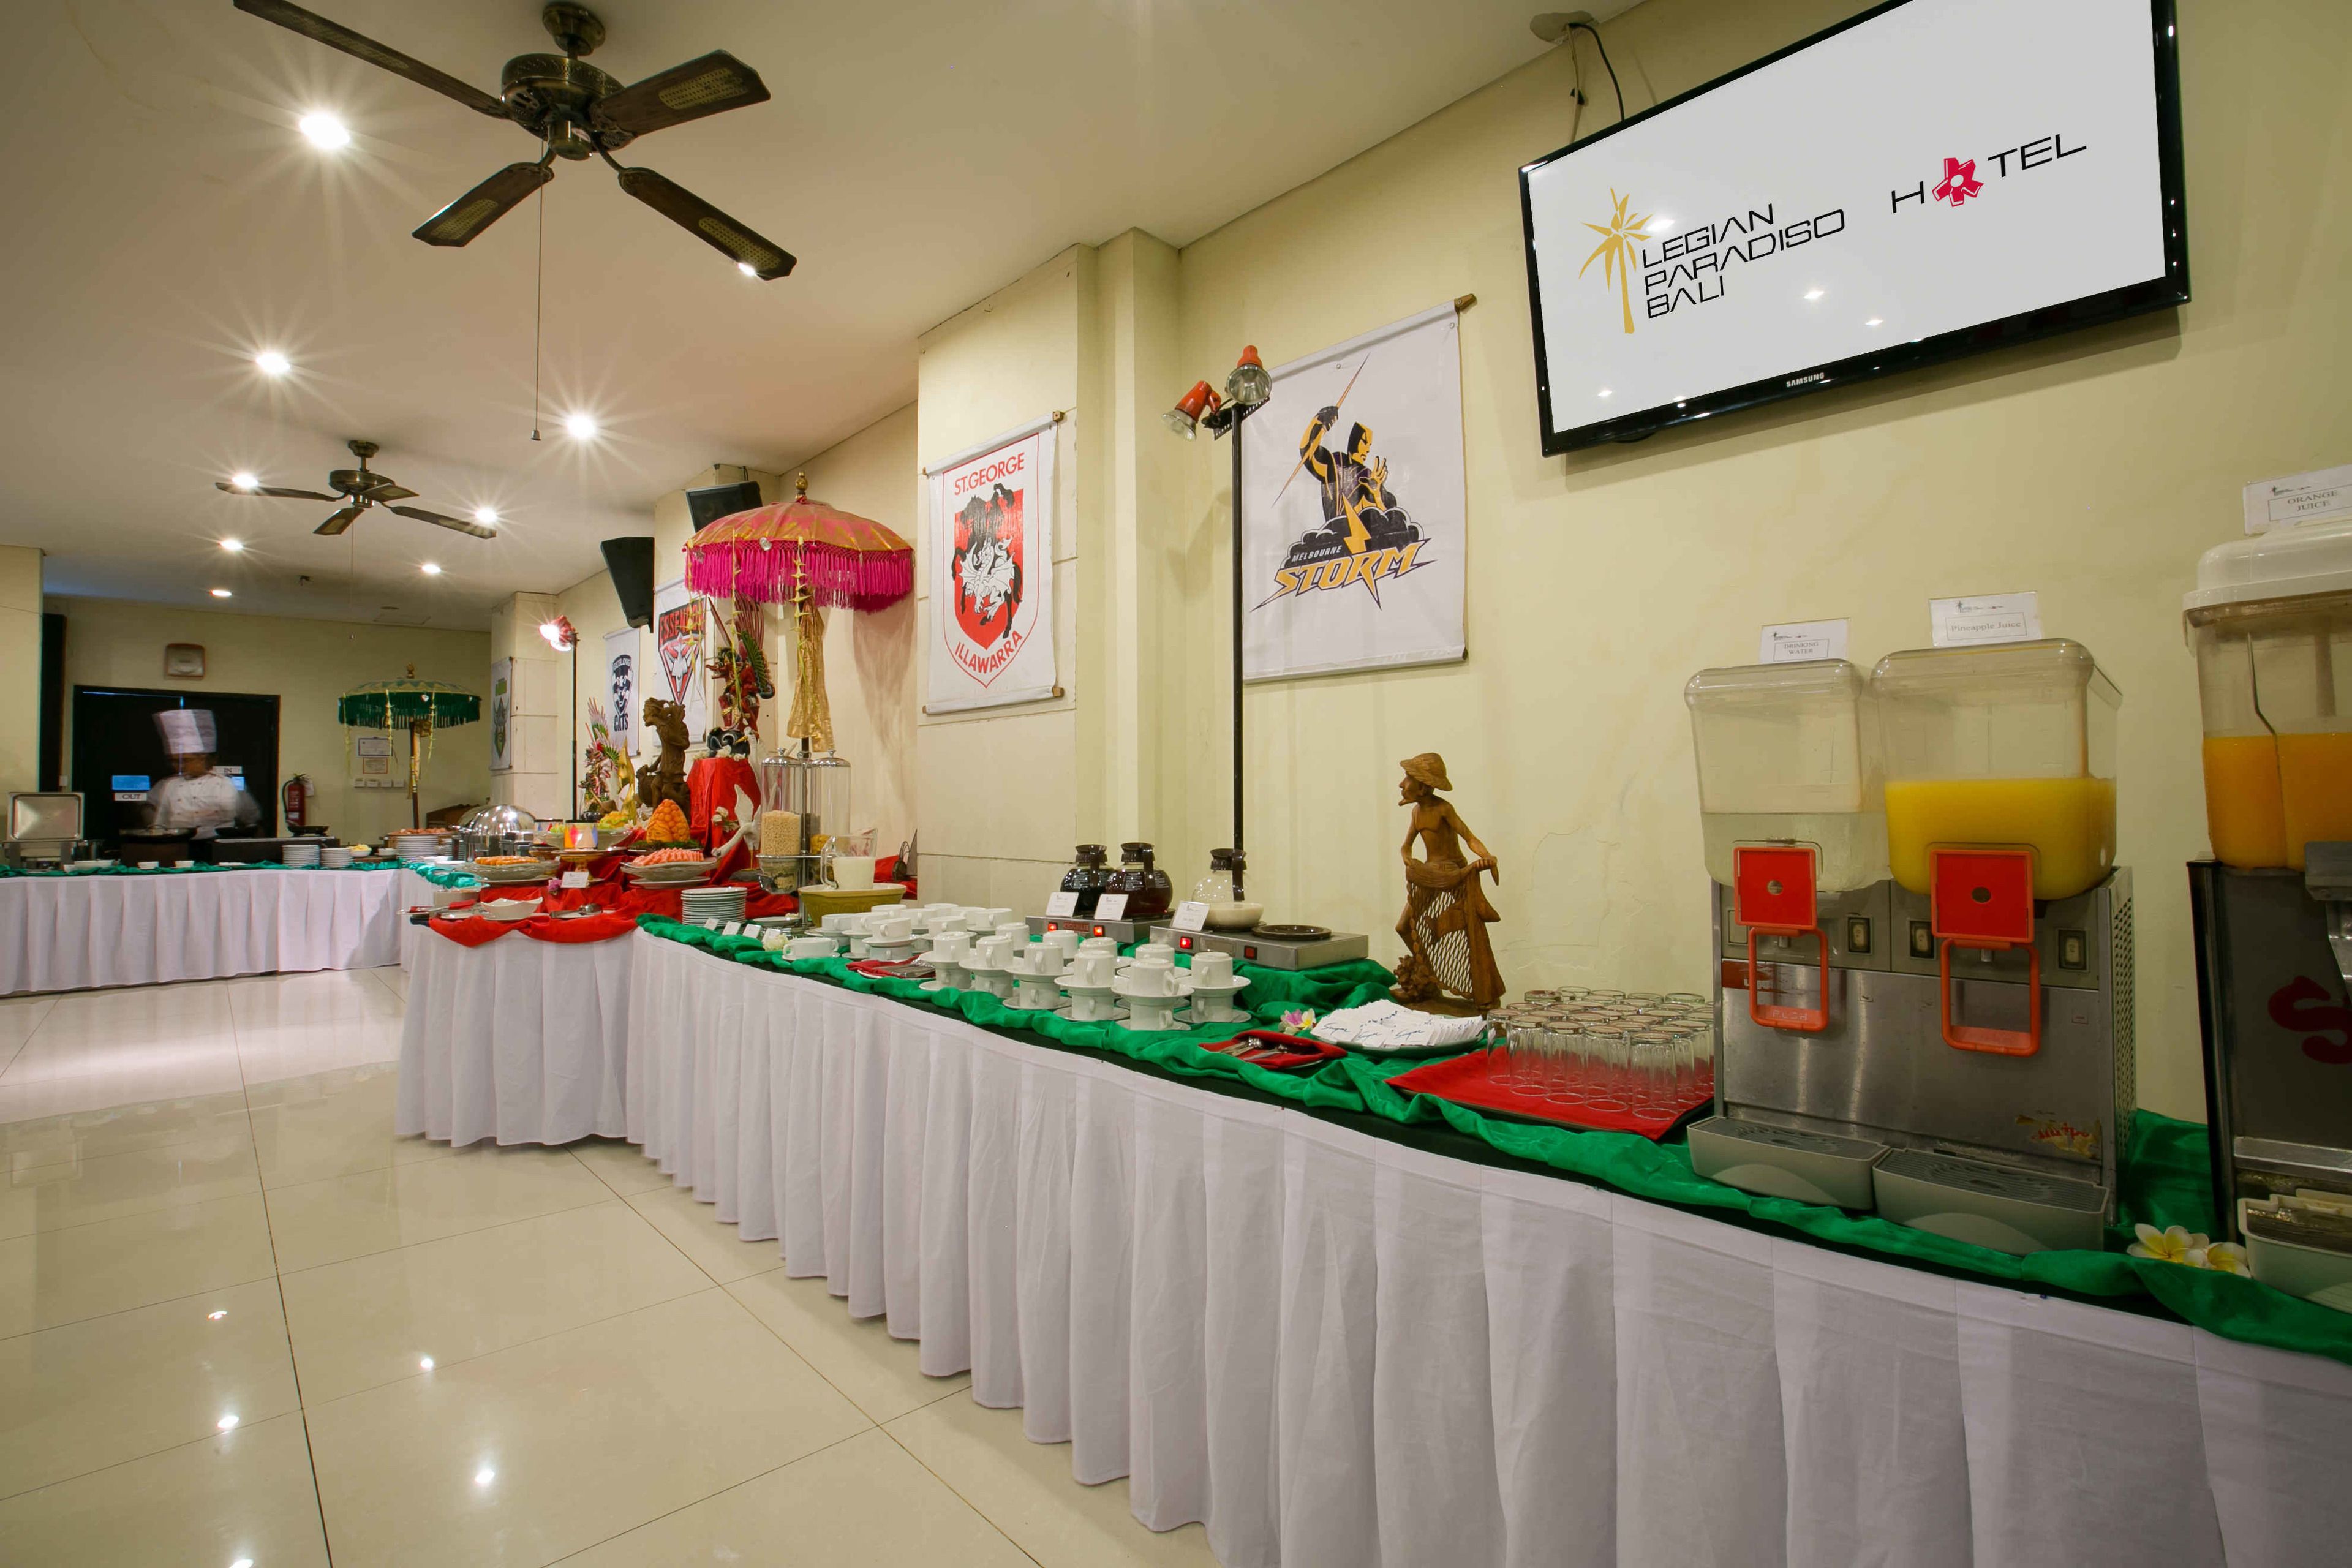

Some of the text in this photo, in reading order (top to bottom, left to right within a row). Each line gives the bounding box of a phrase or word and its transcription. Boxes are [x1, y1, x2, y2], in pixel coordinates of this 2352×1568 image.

[1643, 203, 1774, 268] LEGIAN
[1645, 209, 1845, 295] PARADISO
[1646, 275, 1724, 318] BALI
[1786, 372, 1825, 388] SAMSUNG
[2287, 490, 2339, 505] ORANGE
[2296, 501, 2329, 511] JUICE
[1291, 545, 1343, 562] MELBOURNE
[1250, 538, 1438, 611] STORM
[1951, 622, 1995, 633] Pineapple
[955, 631, 1022, 674] ILLAWARRA
[614, 713, 628, 732] CATS
